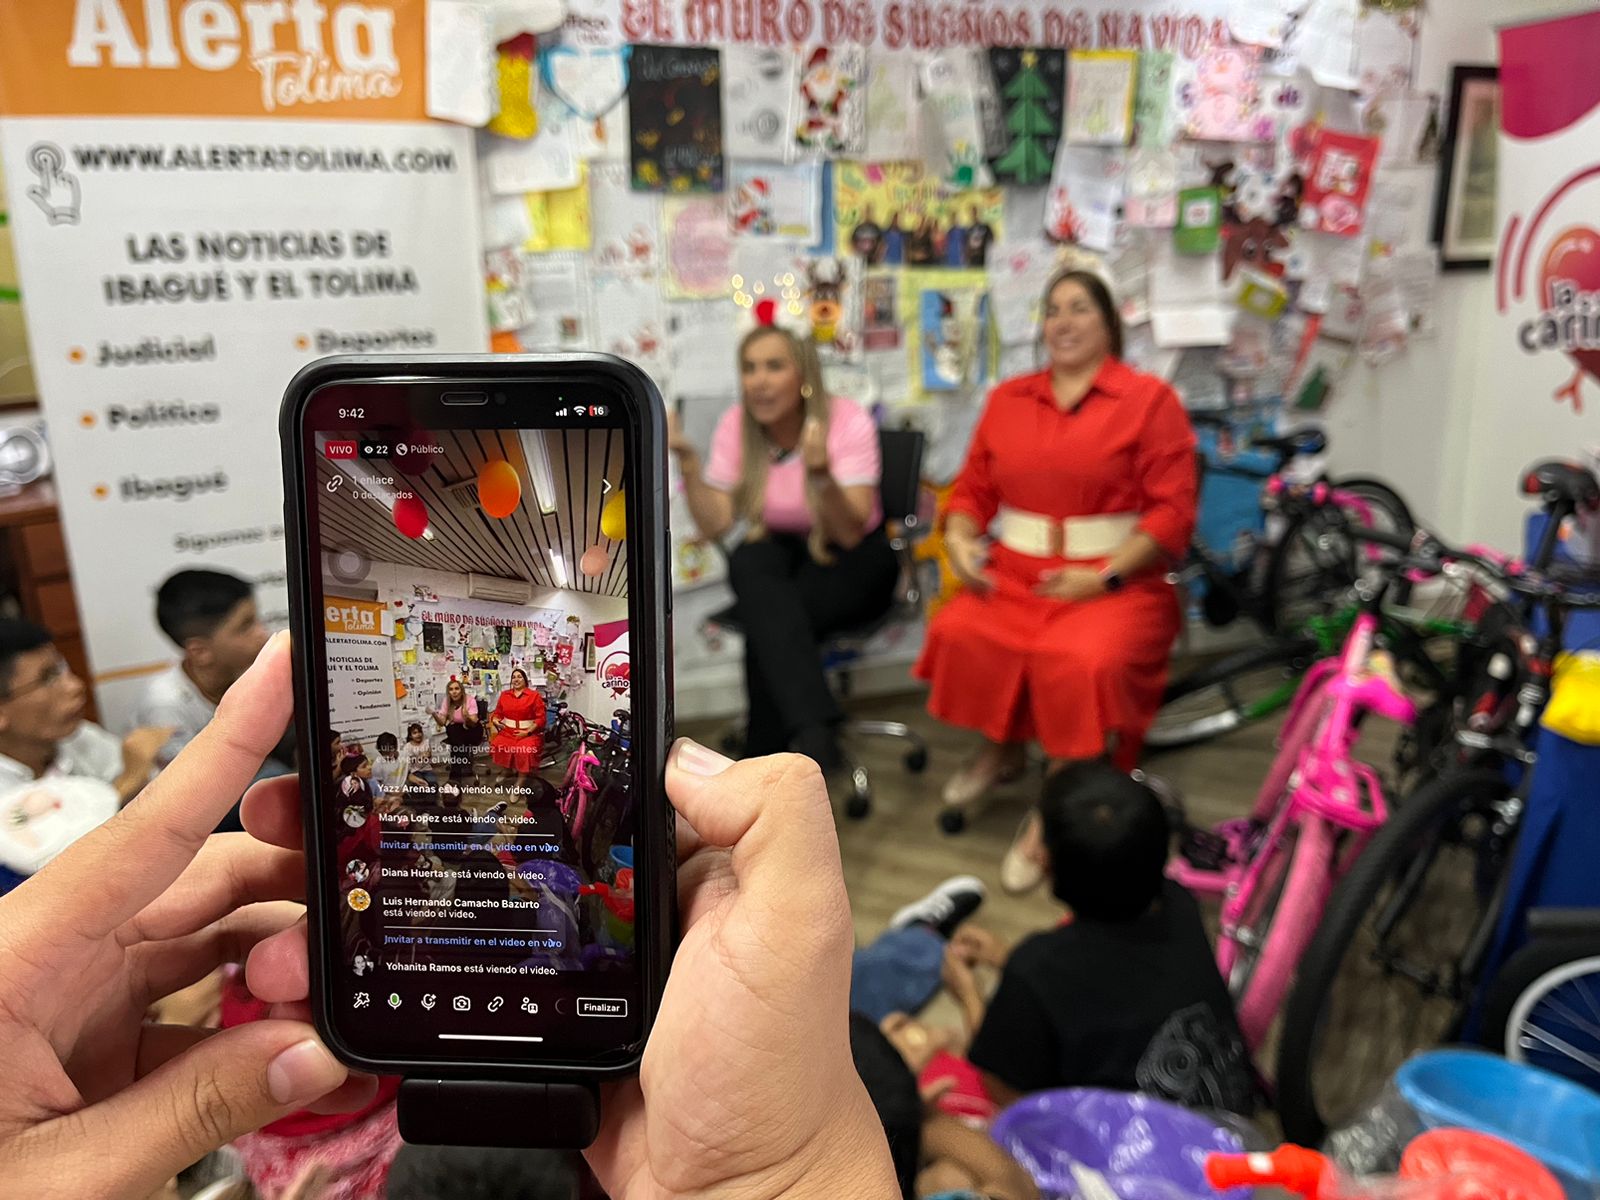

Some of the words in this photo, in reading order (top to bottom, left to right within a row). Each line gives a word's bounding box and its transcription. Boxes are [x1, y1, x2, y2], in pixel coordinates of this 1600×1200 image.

[67, 0, 400, 74] Alerta
[250, 52, 402, 111] Tolima
[72, 145, 457, 173] WWW.ALERTATOLIMA.COM
[126, 232, 188, 264] LAS
[197, 232, 345, 262] NOTICIAS
[352, 231, 392, 259] DE
[103, 270, 230, 306] IBAGUÉ
[237, 274, 258, 299] Y
[267, 273, 300, 298] EL
[308, 266, 419, 296] TOLIMA
[314, 329, 436, 354] Deportes
[97, 335, 216, 367] Judicial
[338, 407, 365, 419] 9:42
[592, 406, 604, 416] 16
[329, 445, 353, 455] VIVO
[375, 445, 389, 455] 22
[410, 444, 444, 455] Público
[360, 475, 394, 486] enlace
[352, 490, 359, 500] 0
[361, 490, 413, 500] destacados
[329, 656, 363, 664] NOTICIAS
[601, 676, 629, 689] cariño
[498, 745, 538, 754] Fuentes
[431, 756, 441, 765] el
[442, 756, 471, 765] video.
[377, 783, 400, 793] Yazz
[402, 784, 436, 794] Arenas
[438, 784, 459, 794] está
[461, 784, 492, 795] viendo
[494, 785, 504, 795] el
[506, 785, 535, 795] video.
[378, 813, 409, 825] Marya
[411, 814, 440, 825] Lopez
[442, 813, 462, 824] está
[464, 814, 496, 824] viendo
[498, 814, 507, 824] el
[509, 814, 538, 825] video.
[379, 840, 410, 850] Invitar
[420, 841, 468, 851] transmitir
[470, 843, 482, 851] en
[484, 842, 494, 851] el
[496, 842, 523, 851] video
[524, 844, 537, 852] en
[381, 867, 409, 878] Diana
[410, 868, 449, 878] Huertas
[451, 868, 472, 879] está
[473, 868, 505, 880] viendo
[507, 869, 516, 880] el
[517, 870, 547, 881] video.
[382, 896, 403, 907] Luis
[404, 897, 452, 908] Hernando
[453, 898, 500, 909] Camacho
[501, 899, 540, 910] Bazurto
[383, 908, 403, 918] está
[405, 908, 437, 919] viendo
[438, 909, 447, 919] el
[449, 909, 477, 919] video.
[384, 934, 415, 944] Invitar
[416, 937, 423, 945] a
[425, 935, 472, 946] transmitir
[473, 938, 486, 946] en
[488, 937, 497, 946] el
[499, 937, 526, 947] video
[527, 938, 540, 948] en
[386, 962, 428, 972] Yohanita
[429, 963, 462, 973] Ramos
[463, 963, 484, 974] está
[486, 963, 517, 975] viendo
[519, 964, 528, 975] el
[529, 965, 559, 976] video.
[583, 1003, 621, 1013] Finalizar
